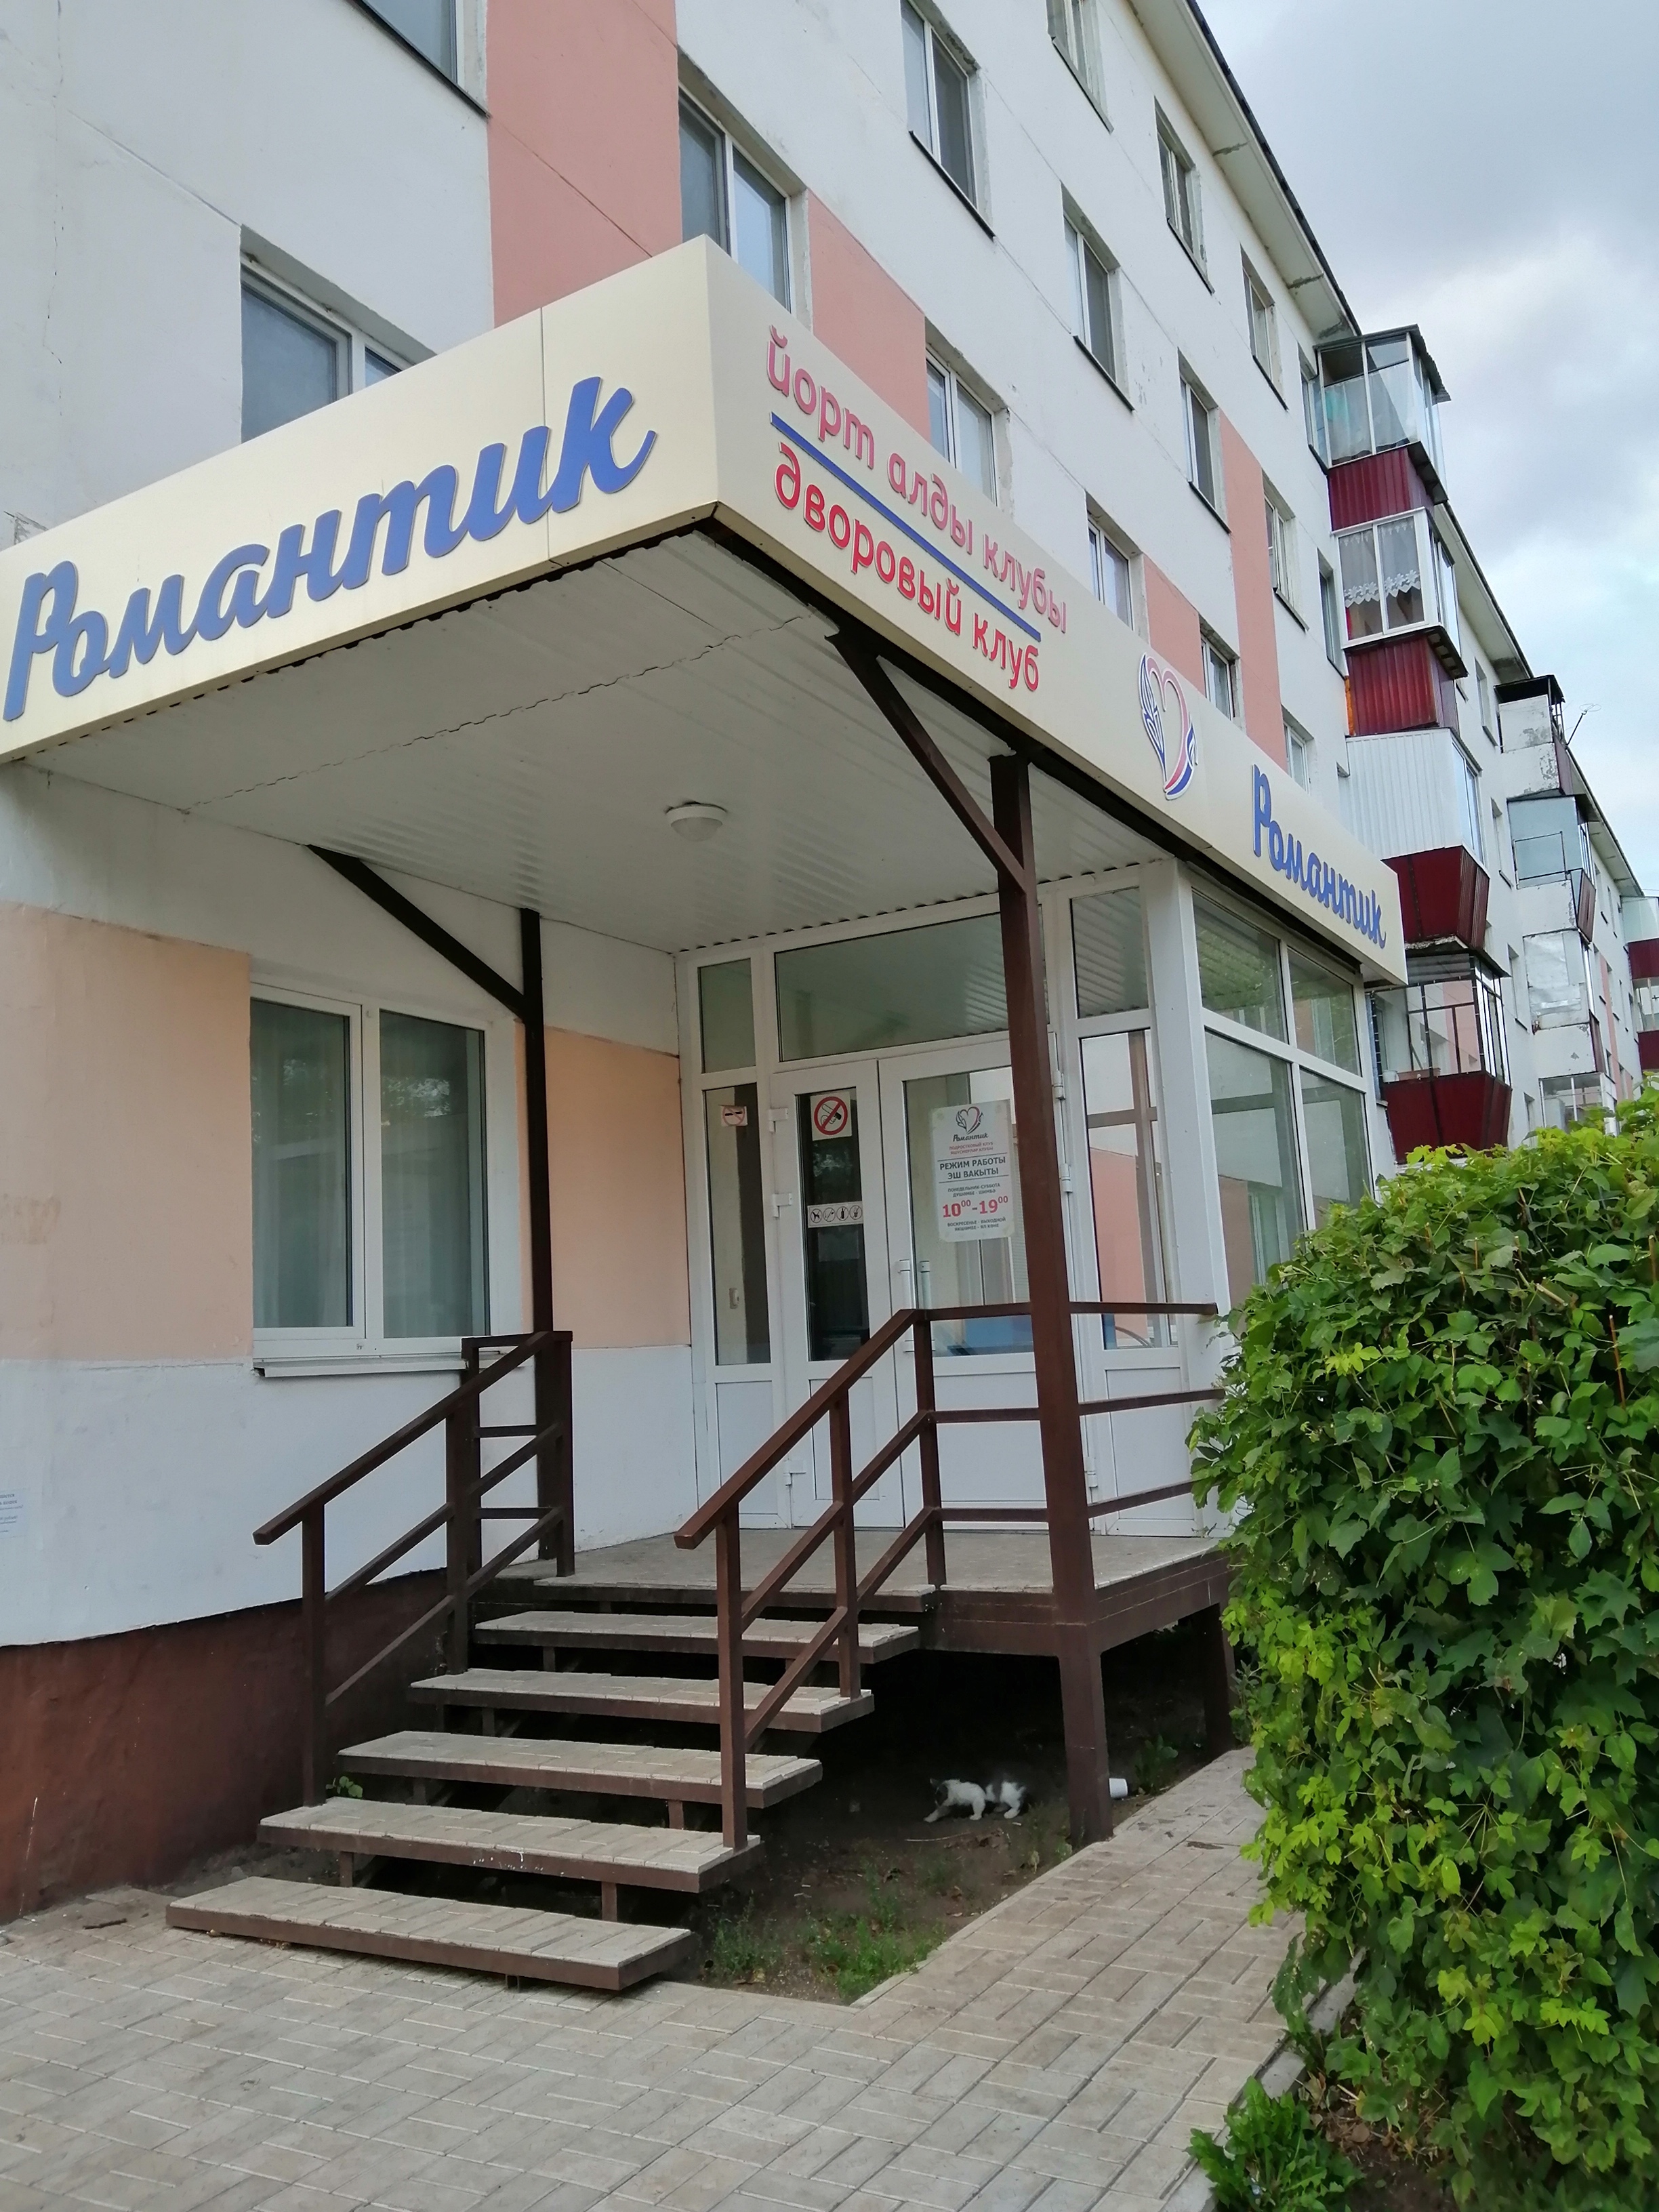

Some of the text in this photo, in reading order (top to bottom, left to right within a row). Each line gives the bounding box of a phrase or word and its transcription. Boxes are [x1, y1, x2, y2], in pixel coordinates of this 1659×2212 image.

[2, 375, 657, 722] Романтик
[766, 324, 1067, 634] йорт алды клубы
[774, 441, 1040, 692] дворовый клуб
[1252, 764, 1387, 949] Романтик
[940, 1156, 1006, 1170] РЕЖИМ РАБОТЫ
[947, 1167, 999, 1180] ЭШ ВАКЫТЫ
[952, 1132, 989, 1143] Романтик
